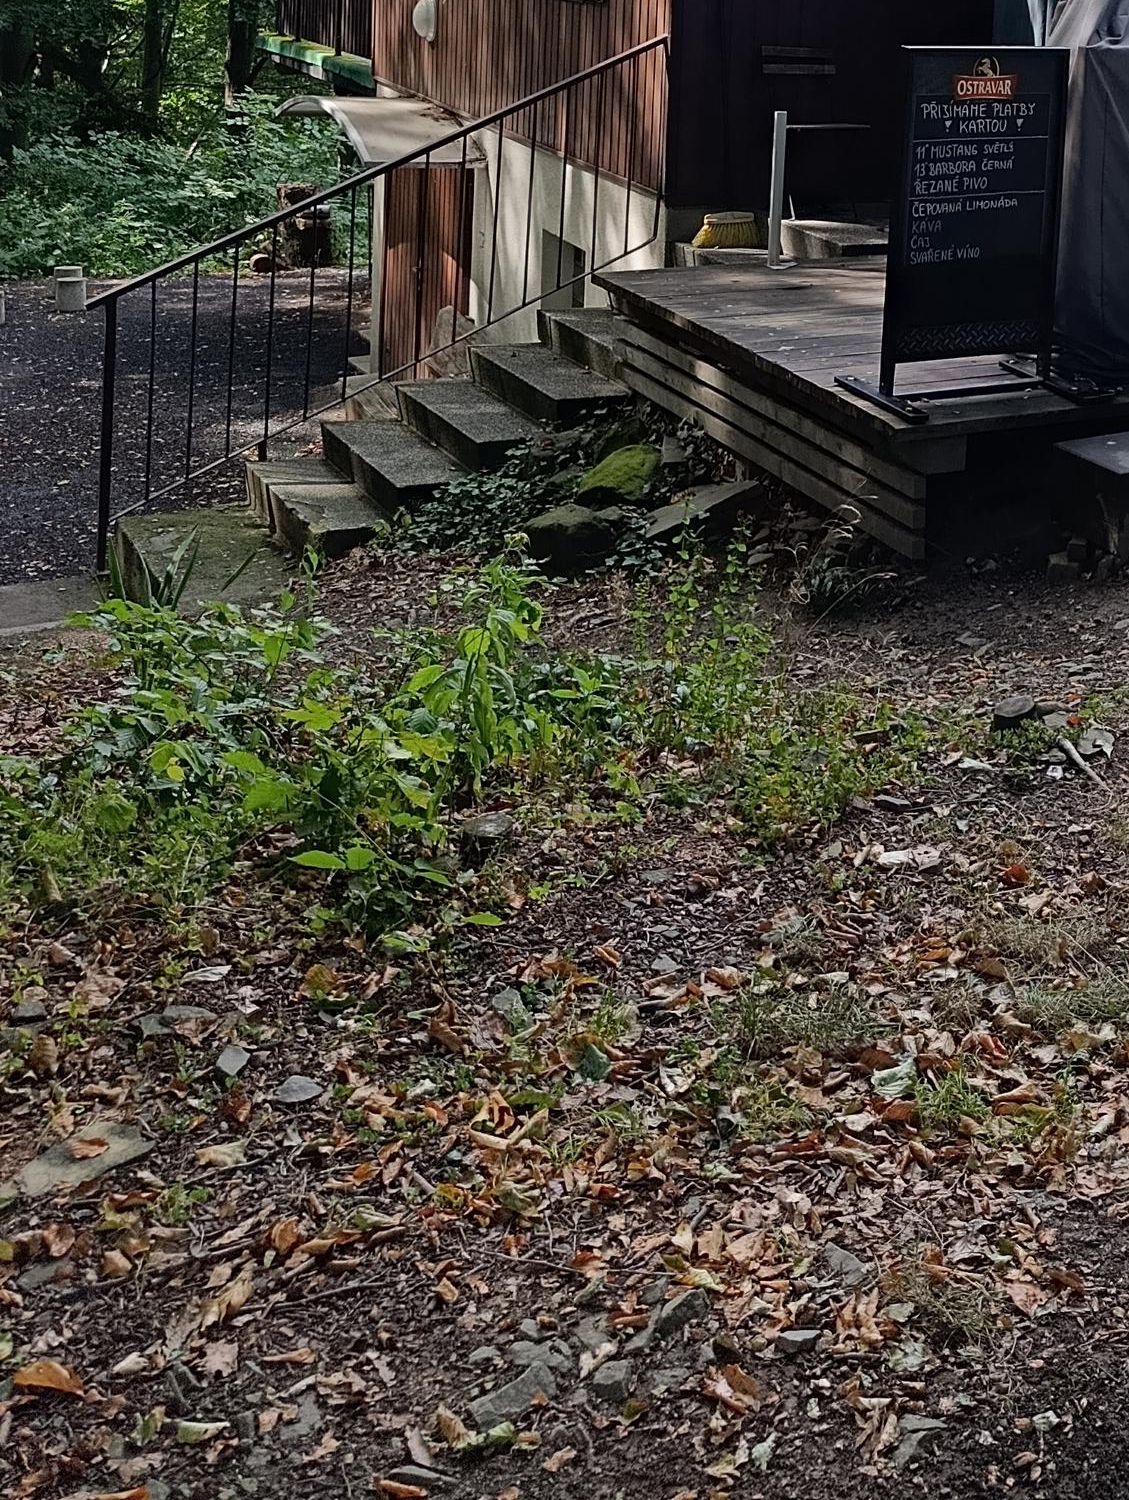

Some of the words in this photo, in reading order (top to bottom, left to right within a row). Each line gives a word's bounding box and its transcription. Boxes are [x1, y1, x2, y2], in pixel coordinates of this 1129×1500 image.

[957, 79, 1012, 96] OSTRAVAR
[992, 102, 1036, 117] PLATBY
[959, 119, 1007, 134] KARTOU
[930, 144, 978, 159] MUSTANG
[929, 160, 976, 177] BARBORA
[981, 156, 1015, 171] ČERNÁ
[914, 175, 960, 196] ŘEZANÉ
[963, 177, 988, 191] PIVO
[912, 198, 963, 218] ČEPOVANÁ
[966, 196, 1018, 211] LIMONÁDA
[911, 218, 942, 234] KÁVA
[957, 244, 981, 259] VÍNO
